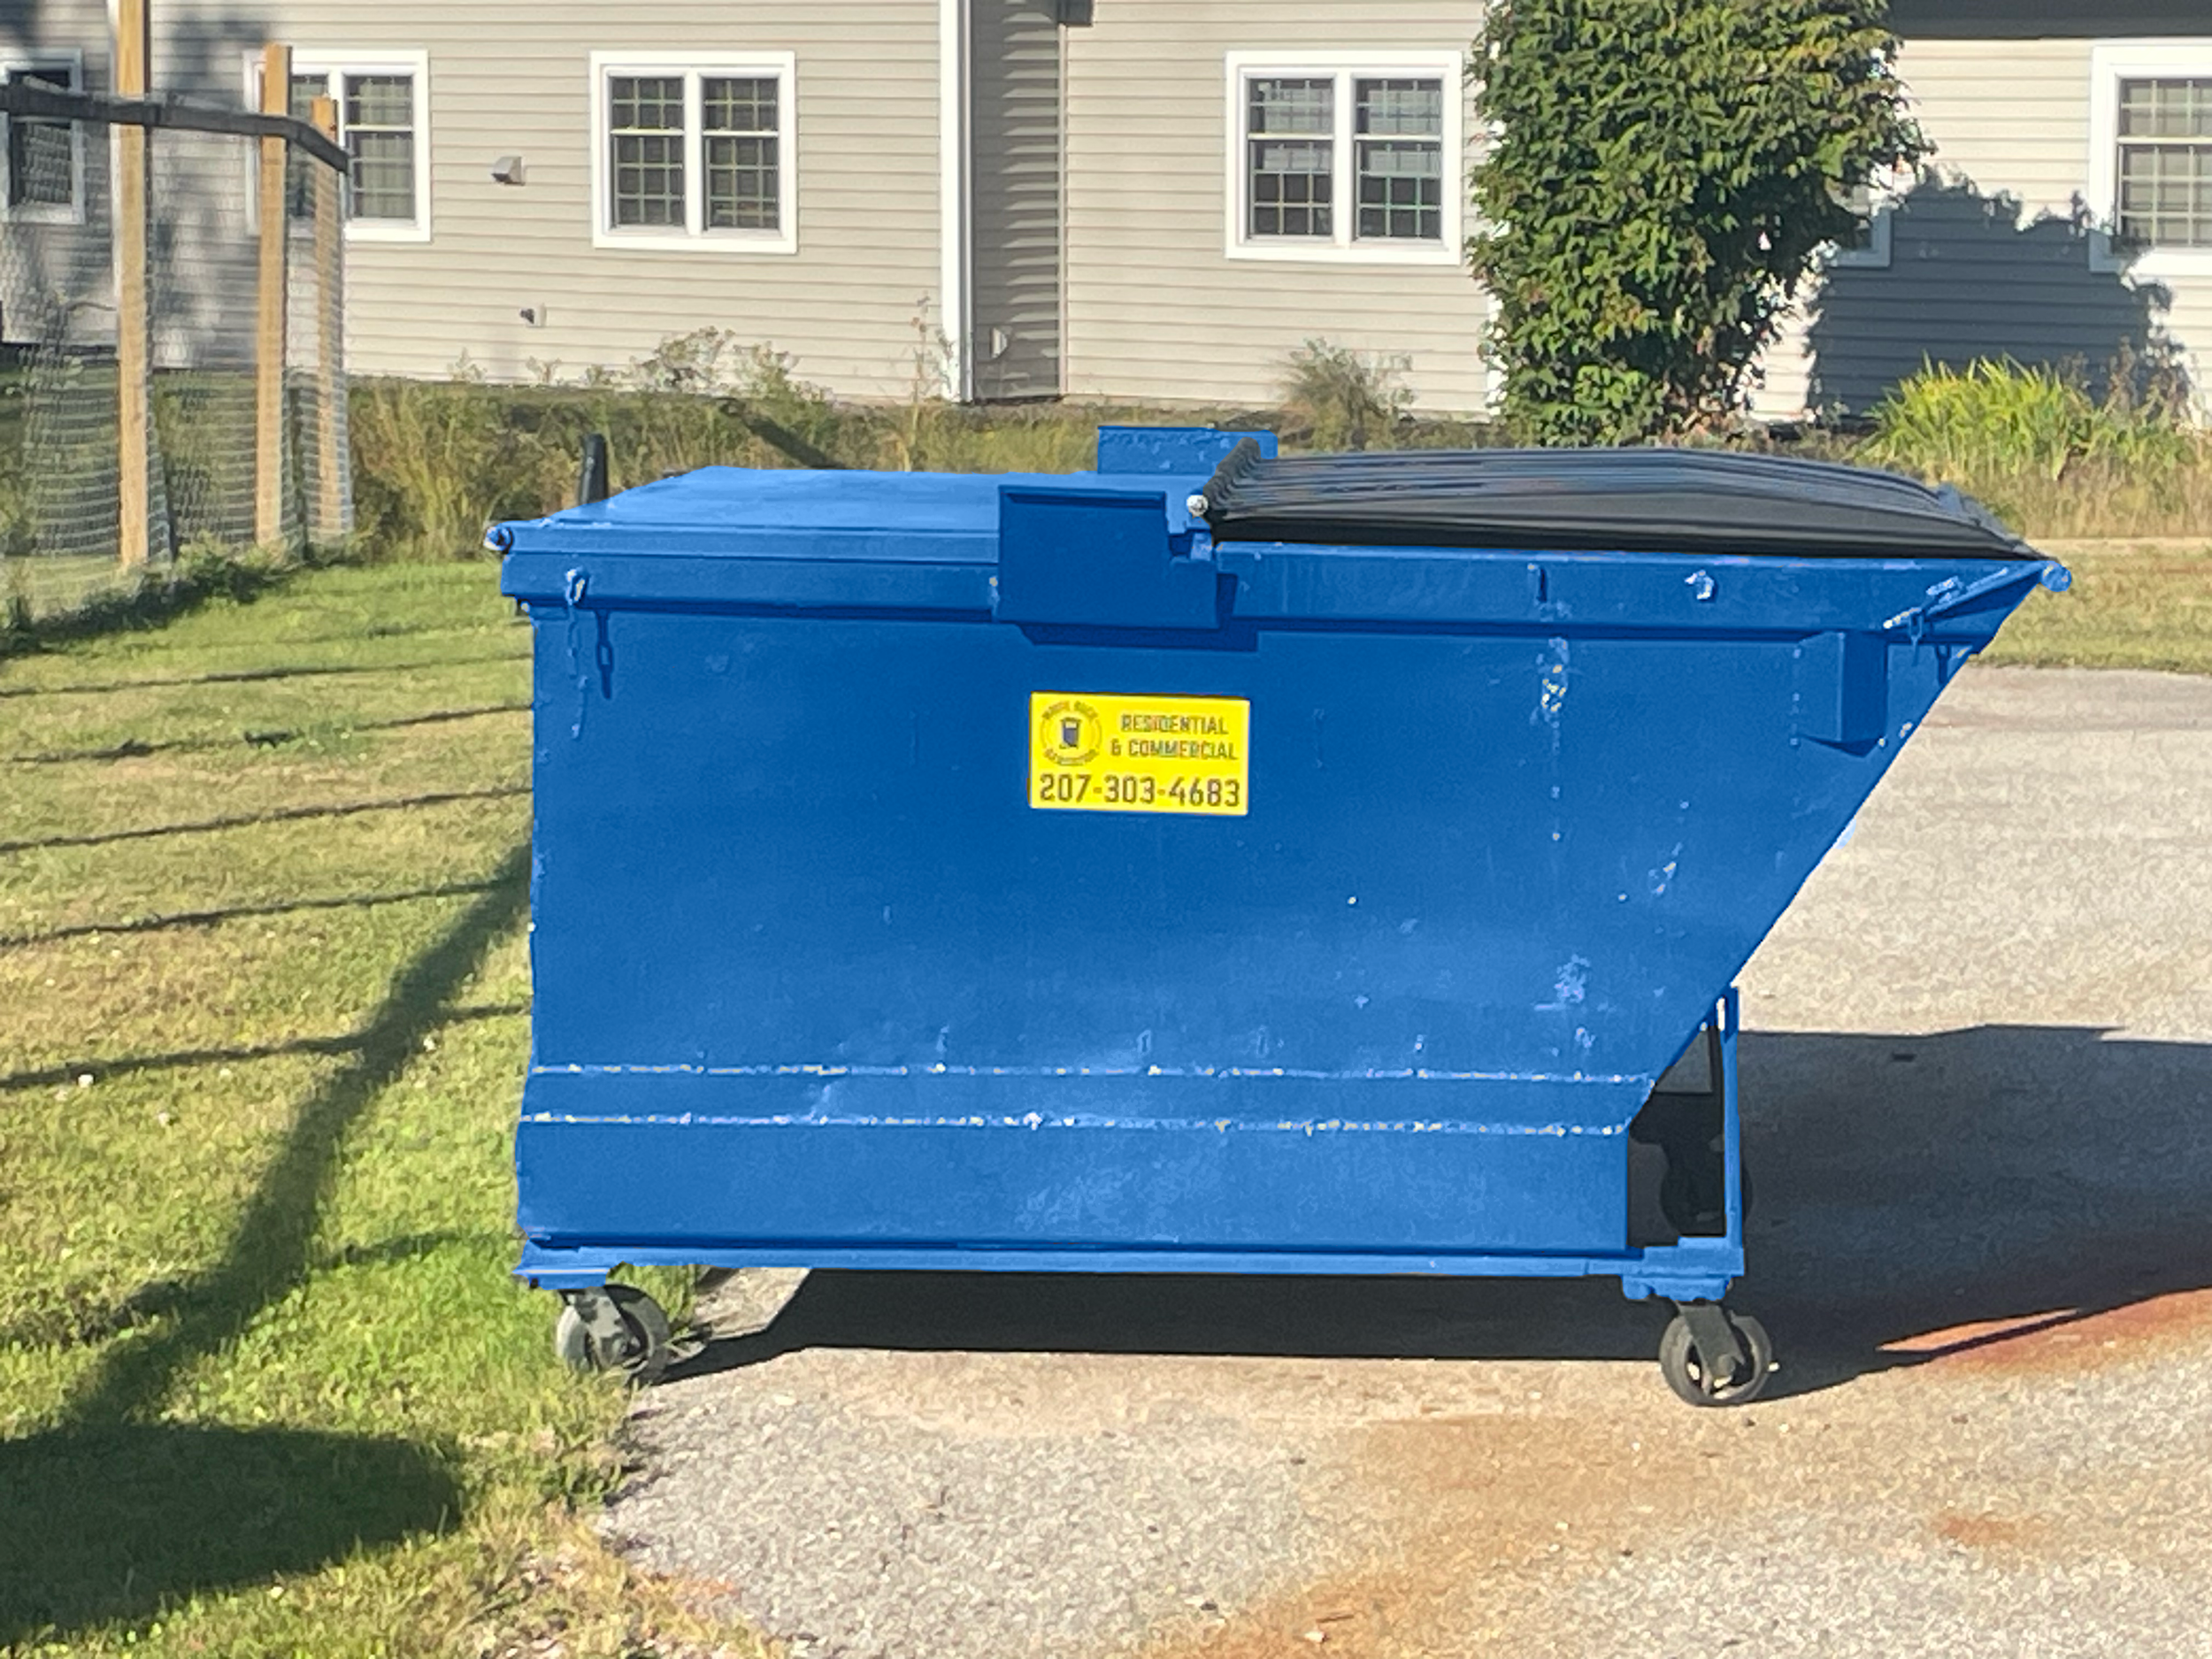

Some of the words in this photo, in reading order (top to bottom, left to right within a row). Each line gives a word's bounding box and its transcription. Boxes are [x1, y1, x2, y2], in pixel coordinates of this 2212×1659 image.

[1121, 714, 1228, 735] RESIDENTIAL
[1111, 739, 1122, 757] &
[1129, 740, 1238, 760] COMMERCIAL
[1040, 773, 1240, 807] 207-303-4683
